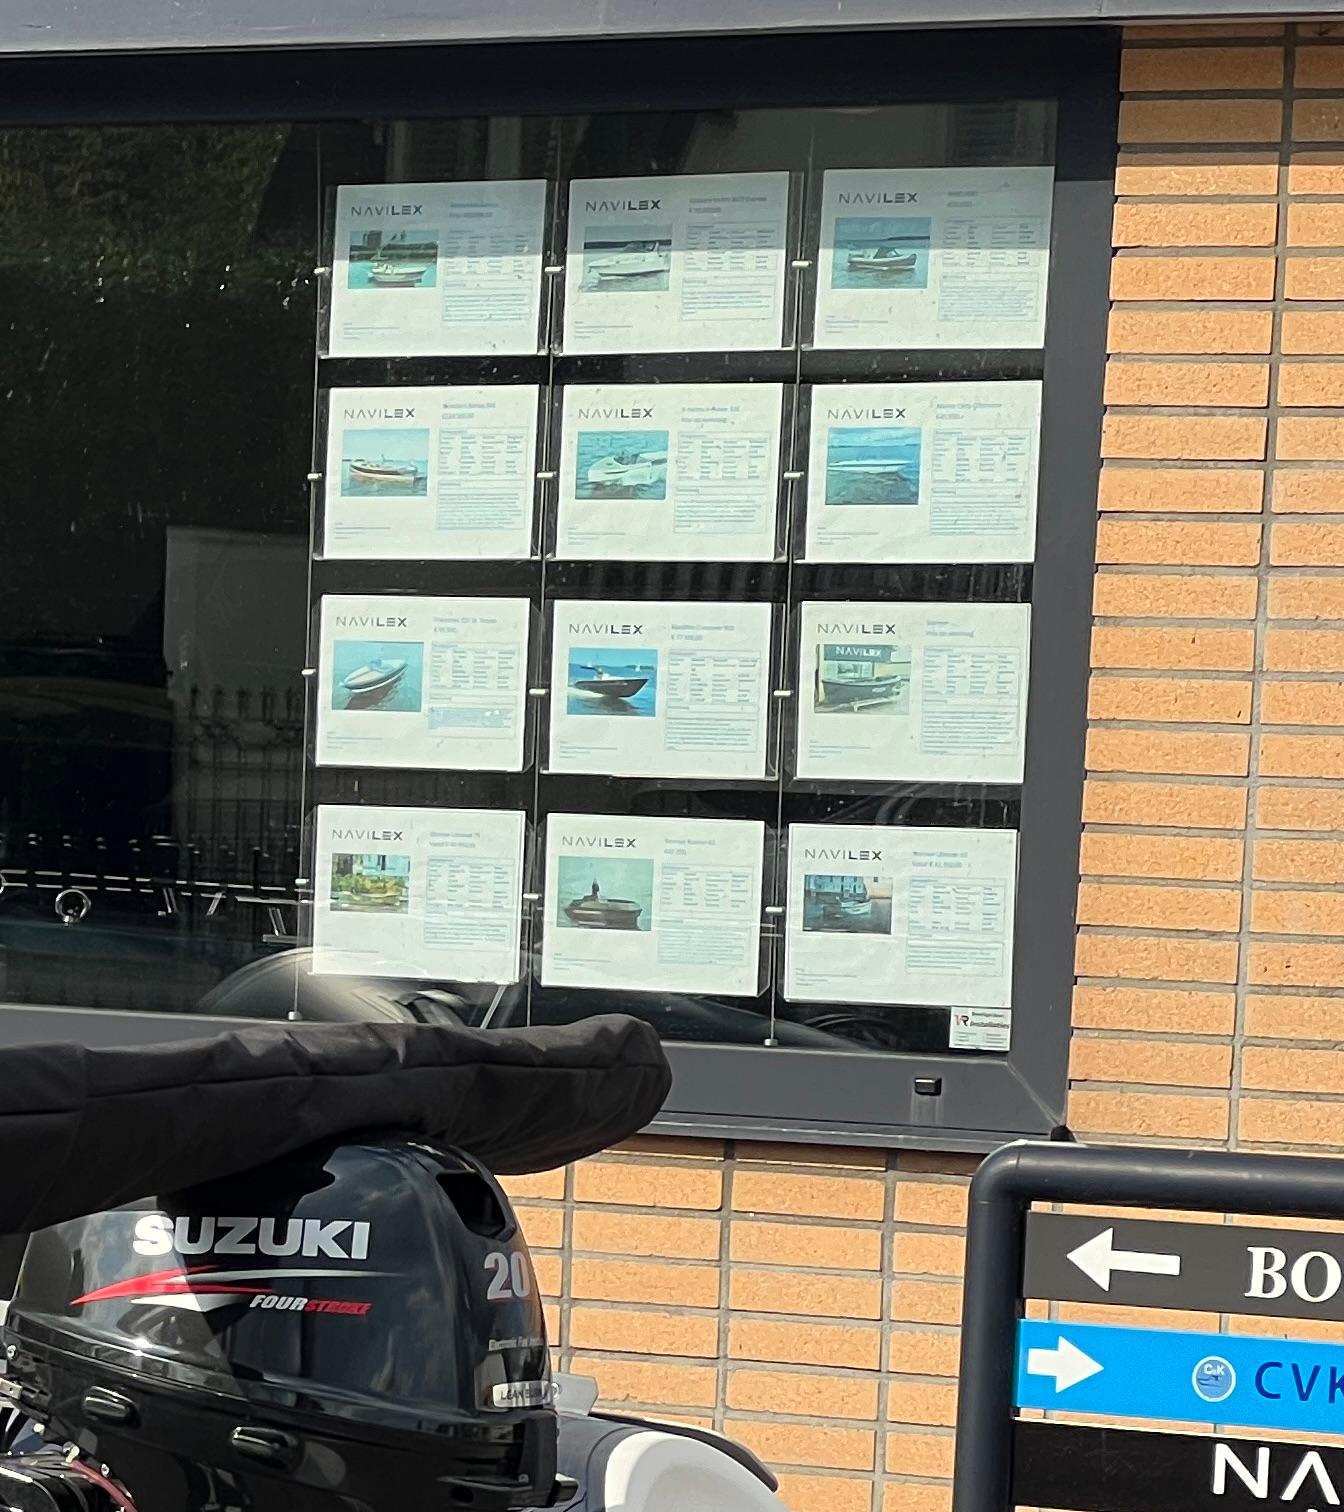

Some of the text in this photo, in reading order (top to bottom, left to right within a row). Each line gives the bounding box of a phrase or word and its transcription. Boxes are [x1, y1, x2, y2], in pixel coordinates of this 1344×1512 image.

[839, 192, 918, 204] NAVILEX
[351, 204, 422, 216] NAVILEX
[586, 199, 661, 212] NAVILEX
[344, 408, 415, 419] NAVILEX
[578, 407, 653, 419] NAVILEX
[827, 407, 906, 419] NAVILEX
[336, 616, 407, 628] NAVILEX
[569, 624, 643, 635] NAVILEX
[817, 622, 896, 635] NAVILEX
[332, 830, 403, 841] NAVILEX
[562, 836, 636, 848] NAVILEX
[804, 848, 882, 861] NAVILEX
[132, 1216, 371, 1260] SUZUKI
[484, 1251, 531, 1300] 20
